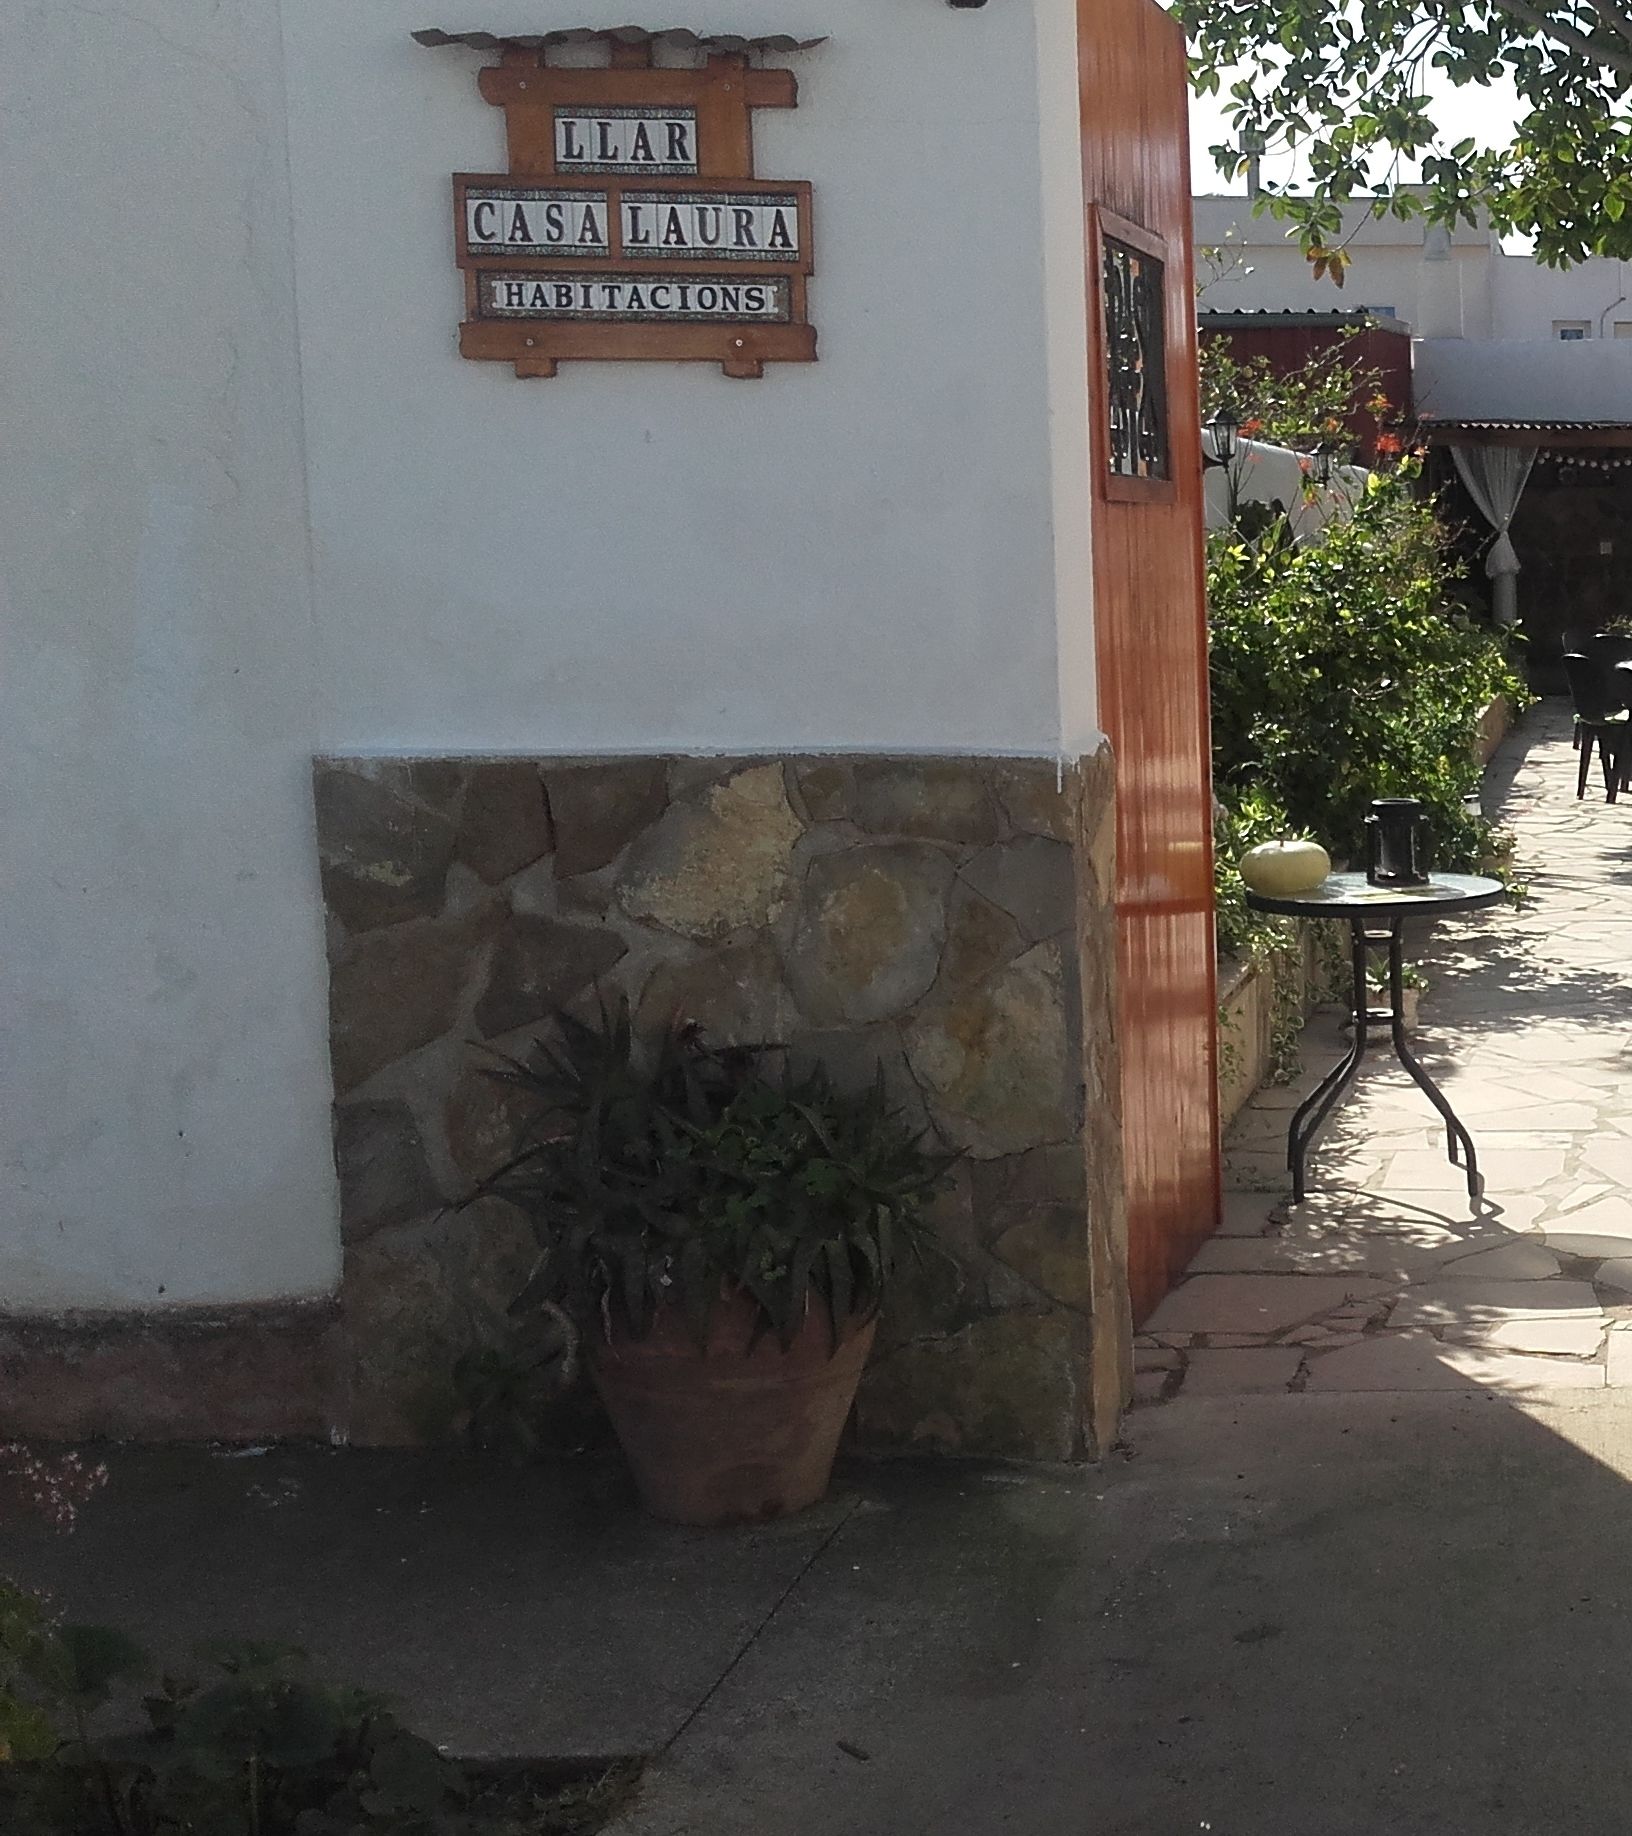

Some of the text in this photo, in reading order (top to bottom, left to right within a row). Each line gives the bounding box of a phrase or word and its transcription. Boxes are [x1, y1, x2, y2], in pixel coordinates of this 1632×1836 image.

[561, 120, 691, 162] LLAR
[473, 201, 794, 249] CASA LAURA
[505, 282, 766, 311] HABITACIONS
